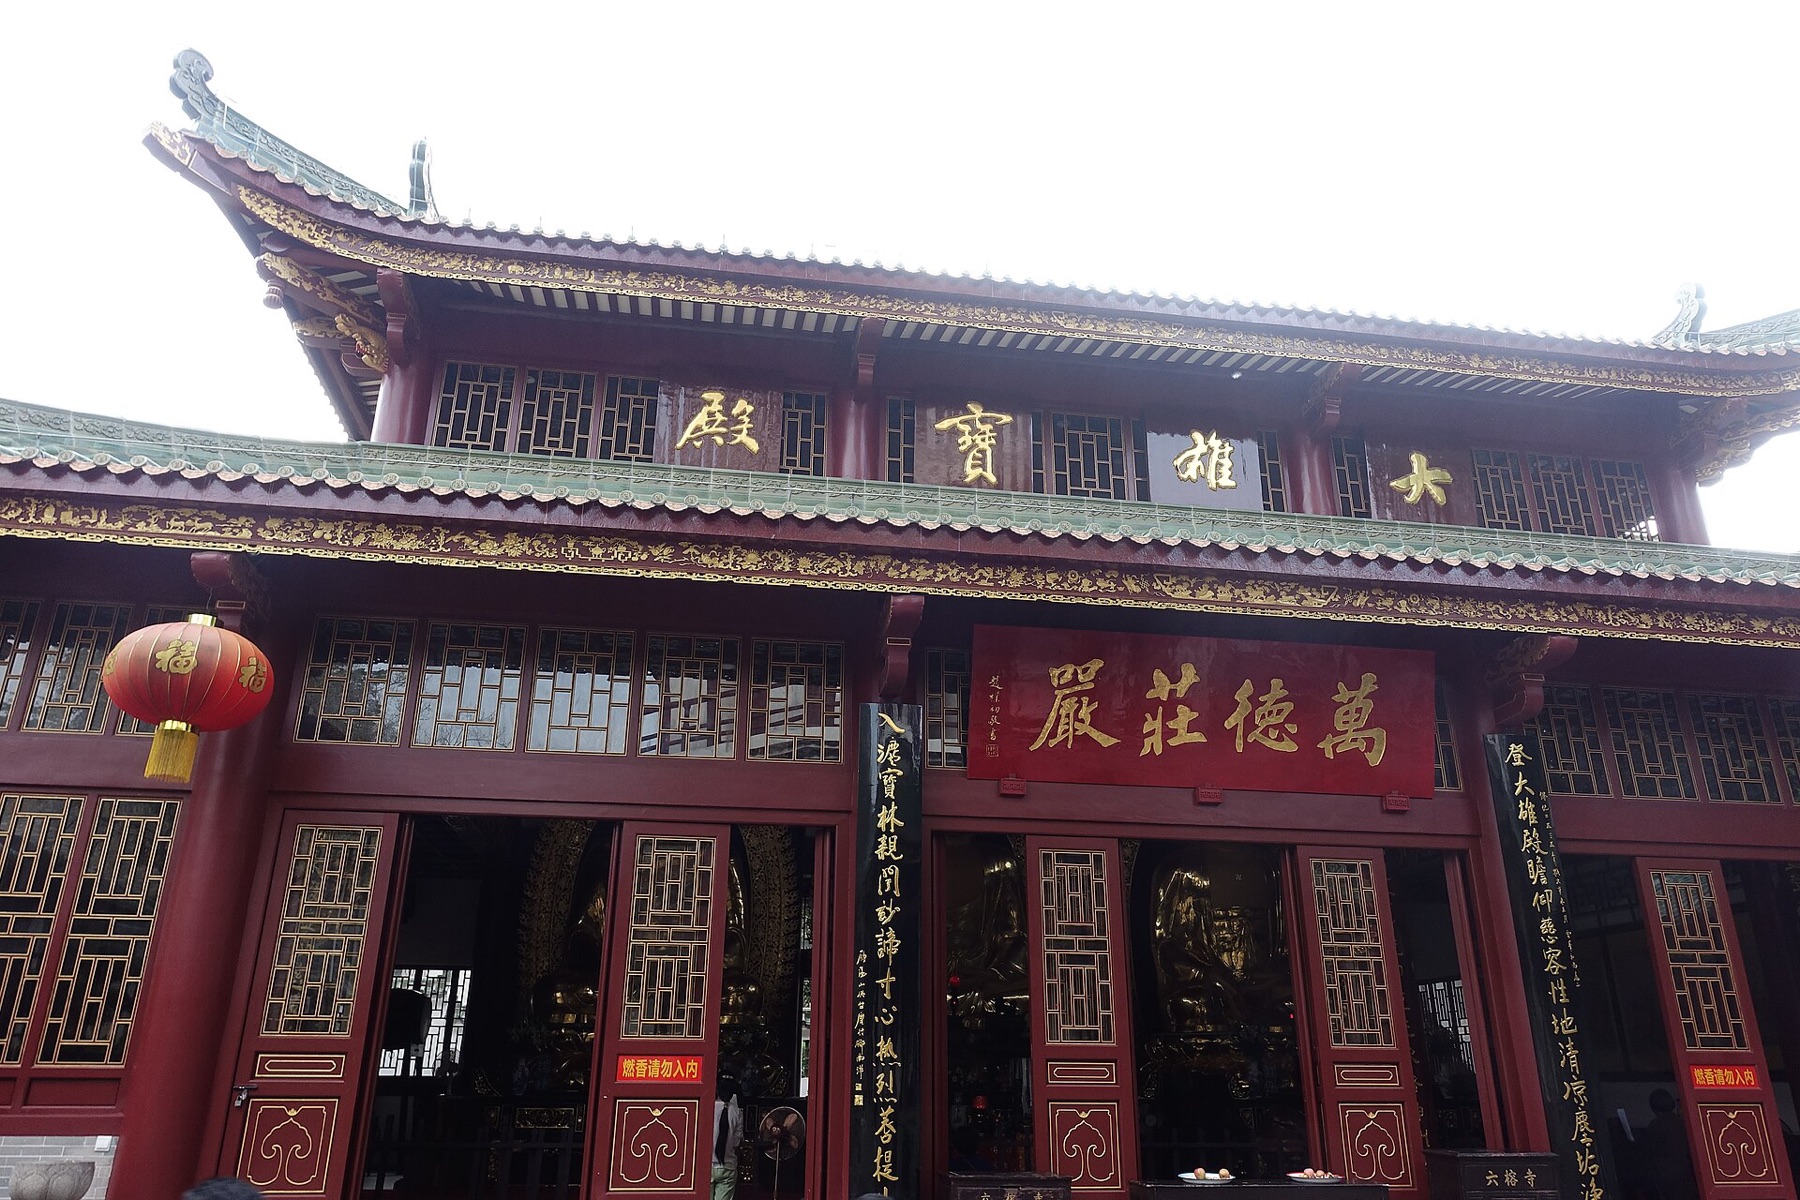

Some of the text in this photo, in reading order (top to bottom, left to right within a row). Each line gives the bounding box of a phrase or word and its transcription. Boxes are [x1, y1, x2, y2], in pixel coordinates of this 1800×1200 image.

[155, 639, 198, 675] 福
[238, 656, 267, 693] 福
[622, 1058, 699, 1079] 燃香请勿入内
[1693, 1067, 1755, 1086] 燃香请勿入内
[1485, 1168, 1538, 1188] 六榕寺
